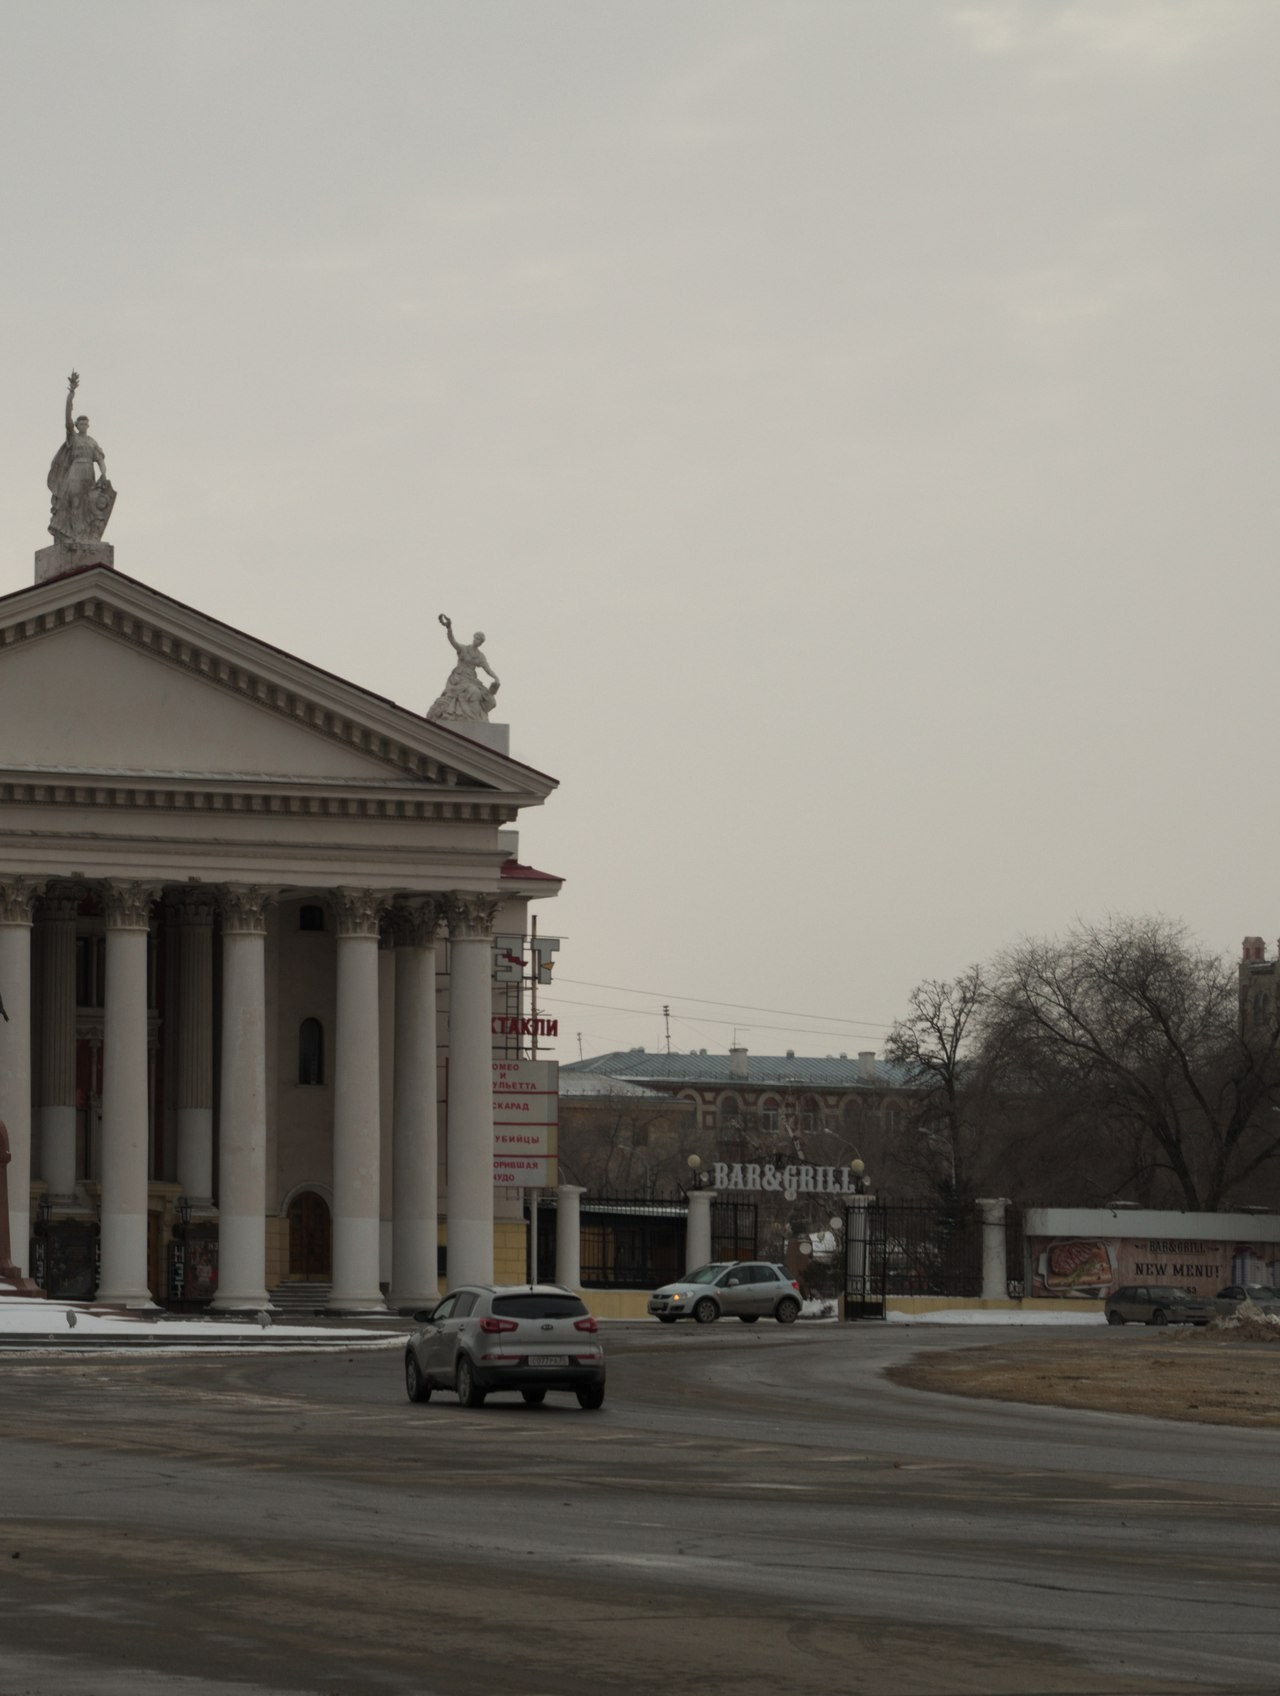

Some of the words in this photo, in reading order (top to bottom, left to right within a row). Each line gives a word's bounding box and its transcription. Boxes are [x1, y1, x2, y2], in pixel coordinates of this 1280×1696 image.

[495, 1135, 539, 1144] УБИЙЦЫ
[712, 1162, 856, 1194] BAR&GRILL
[1135, 1263, 1167, 1277] NEW
[1172, 1264, 1220, 1279] MENU!
